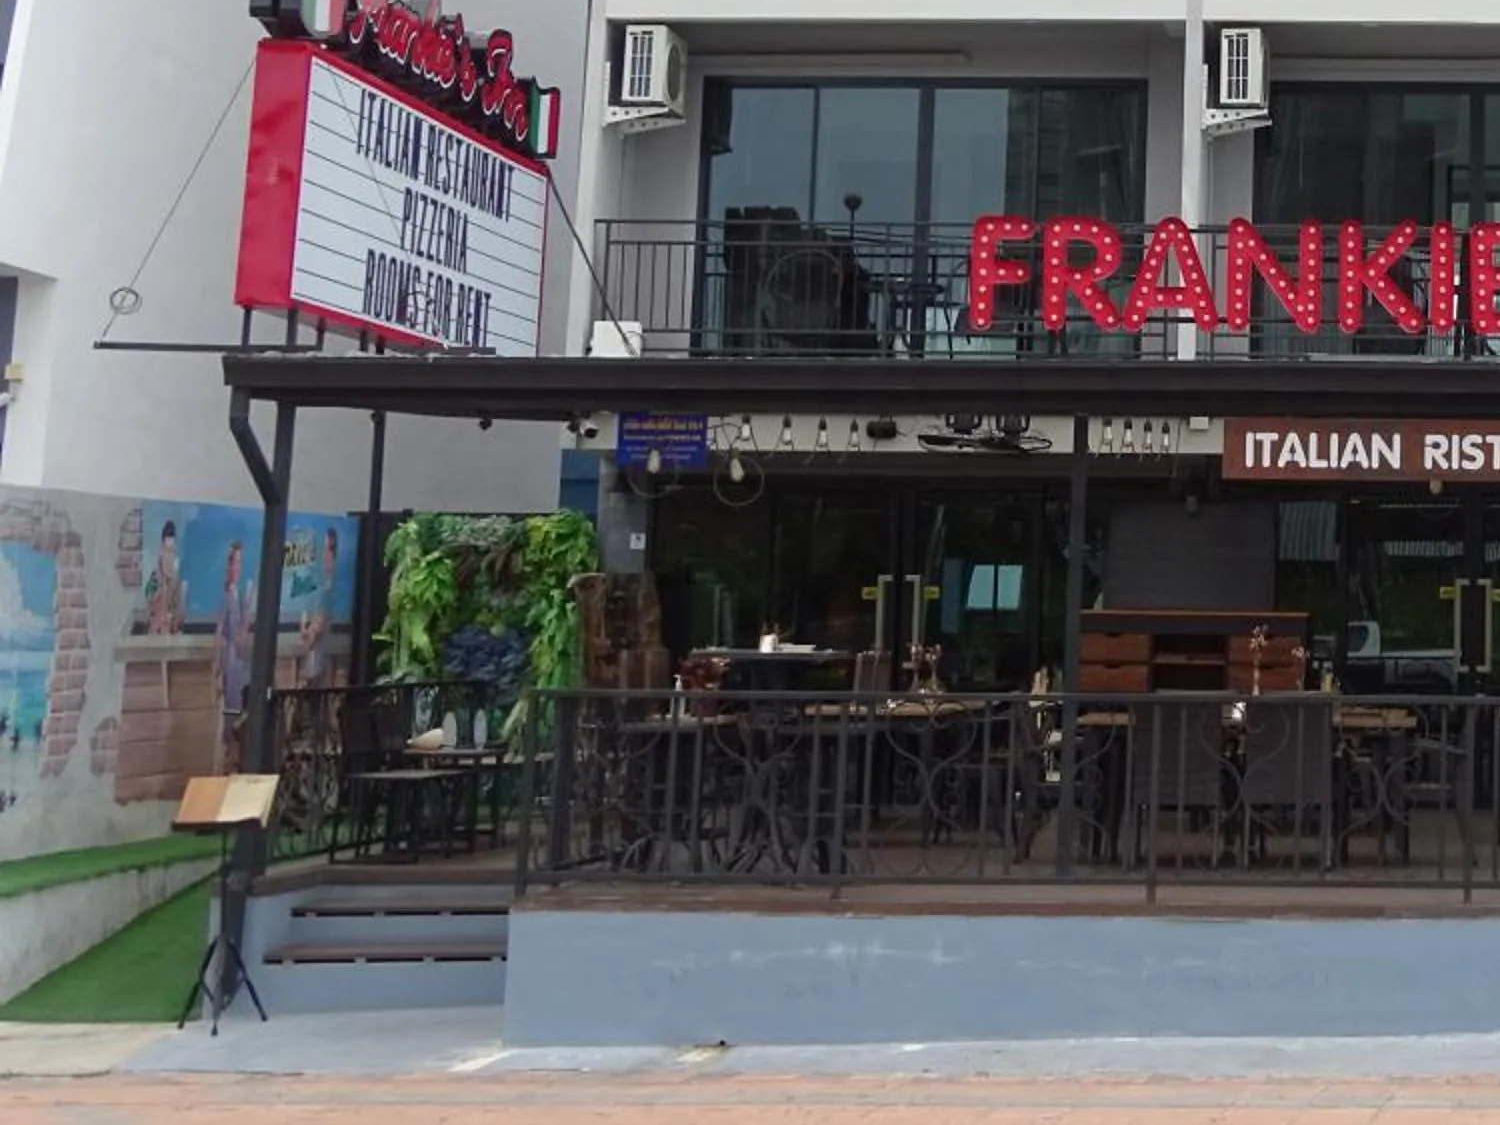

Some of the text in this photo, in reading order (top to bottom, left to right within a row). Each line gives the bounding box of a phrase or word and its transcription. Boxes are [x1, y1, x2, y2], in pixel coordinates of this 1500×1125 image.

[356, 88, 515, 223] ITALIAN RESTAURANT
[400, 187, 469, 274] PIZZERIA
[362, 249, 492, 348] ROOMS FOR RENT
[1245, 431, 1401, 469] ITALIAN
